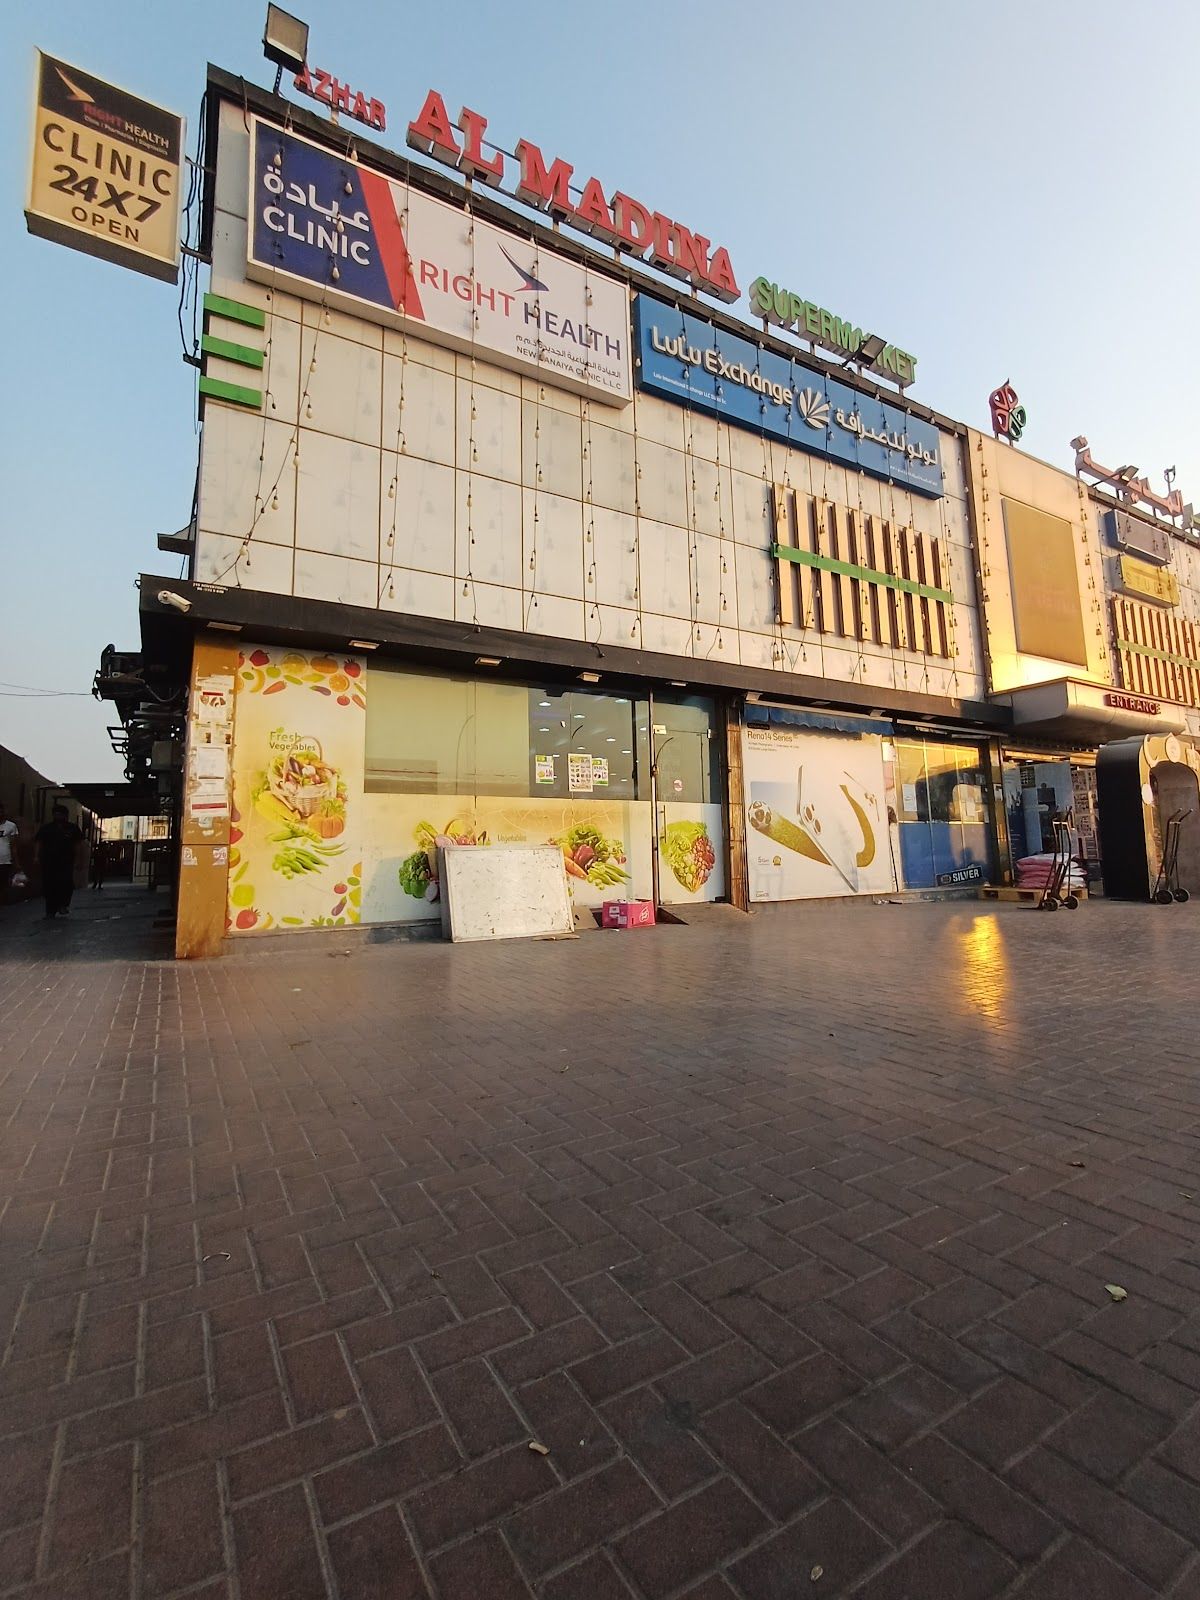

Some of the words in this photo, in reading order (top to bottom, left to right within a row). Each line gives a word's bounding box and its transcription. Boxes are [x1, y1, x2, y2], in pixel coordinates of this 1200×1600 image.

[293, 62, 386, 131] AZHAR
[43, 123, 172, 196] CLINIC
[124, 120, 169, 149] HEALTH
[49, 164, 161, 223] 24X7
[263, 165, 370, 232] عيادة
[407, 89, 503, 183] AL
[516, 138, 740, 301] MADINA
[71, 206, 139, 243] OPEN
[263, 206, 370, 265] CLINIC
[420, 259, 515, 317] RIGHT
[524, 302, 621, 361] HEALTH
[516, 346, 537, 359] NEW
[539, 352, 574, 373] ANAIYA
[651, 325, 701, 365] LuLu
[704, 350, 793, 405] Exchange
[835, 407, 906, 451] للصرافة
[907, 442, 938, 466] لولو
[1110, 694, 1162, 715] ENTRANCE
[269, 731, 303, 742] Fresh
[952, 868, 980, 882] SILVER
